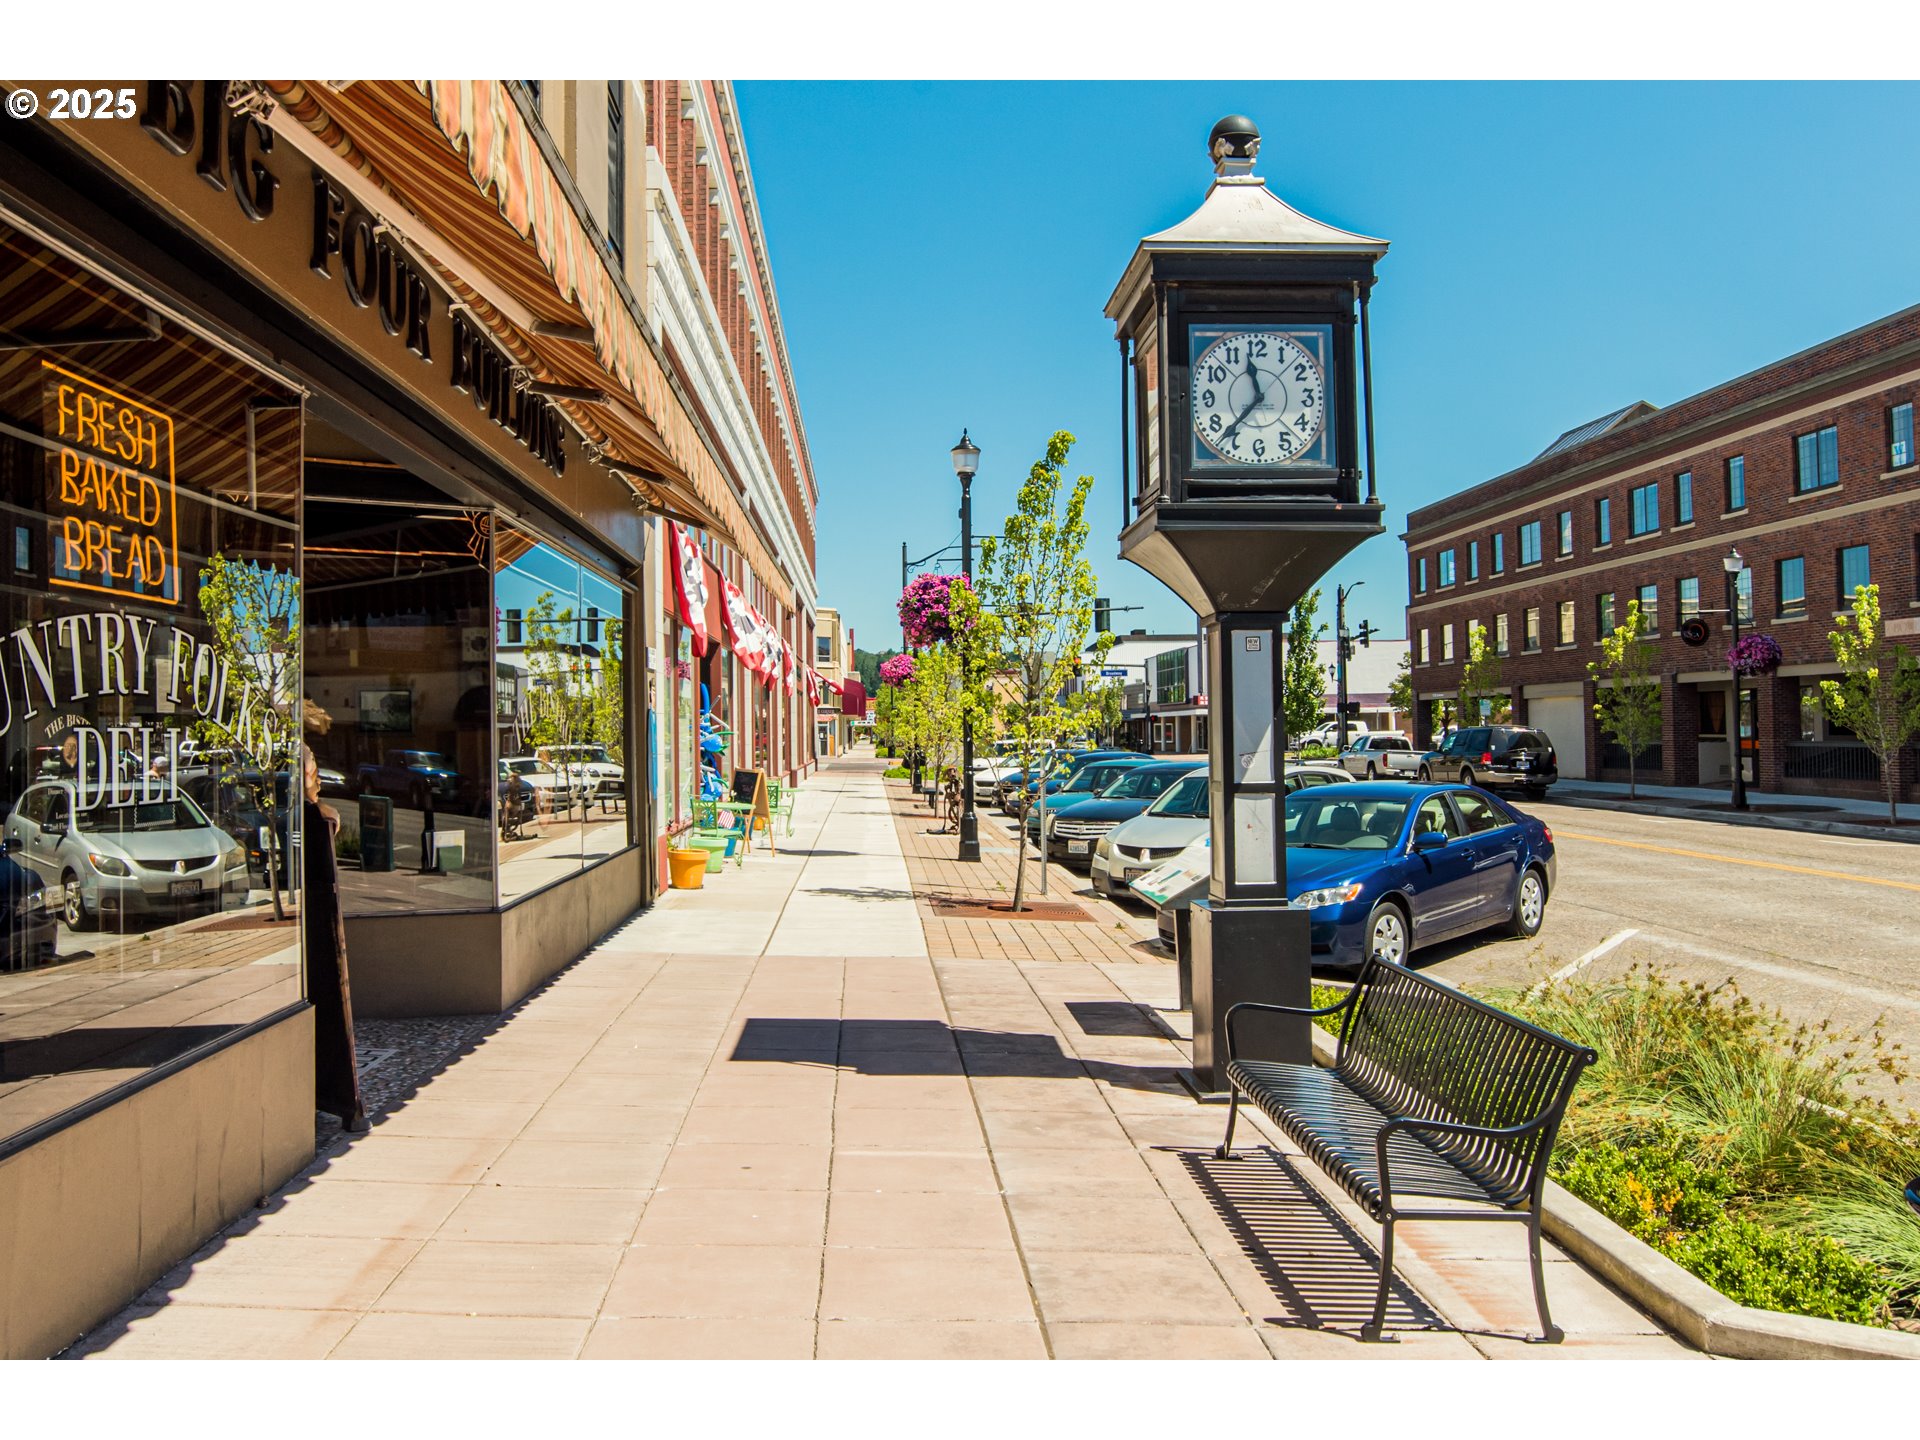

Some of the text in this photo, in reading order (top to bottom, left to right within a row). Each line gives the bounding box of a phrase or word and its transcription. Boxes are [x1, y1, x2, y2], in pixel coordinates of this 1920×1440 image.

[310, 167, 433, 364] FOUR
[1225, 346, 1239, 365] 11
[1247, 339, 1268, 358] 12
[1278, 345, 1285, 365] 1
[1207, 364, 1227, 383] 10
[1294, 363, 1308, 382] 2
[1202, 388, 1215, 408] 9
[1301, 388, 1315, 408] 3
[58, 384, 158, 470] FRESH
[1209, 413, 1223, 433] 8
[1293, 413, 1310, 432] 4
[1252, 438, 1266, 458] 6
[1278, 431, 1292, 451] 5
[60, 447, 161, 527] BAKED
[63, 516, 166, 586] BREAD
[167, 625, 279, 772] FOLKS
[44, 716, 65, 739] THE
[67, 714, 92, 729] BIST
[73, 727, 181, 812] DELI
